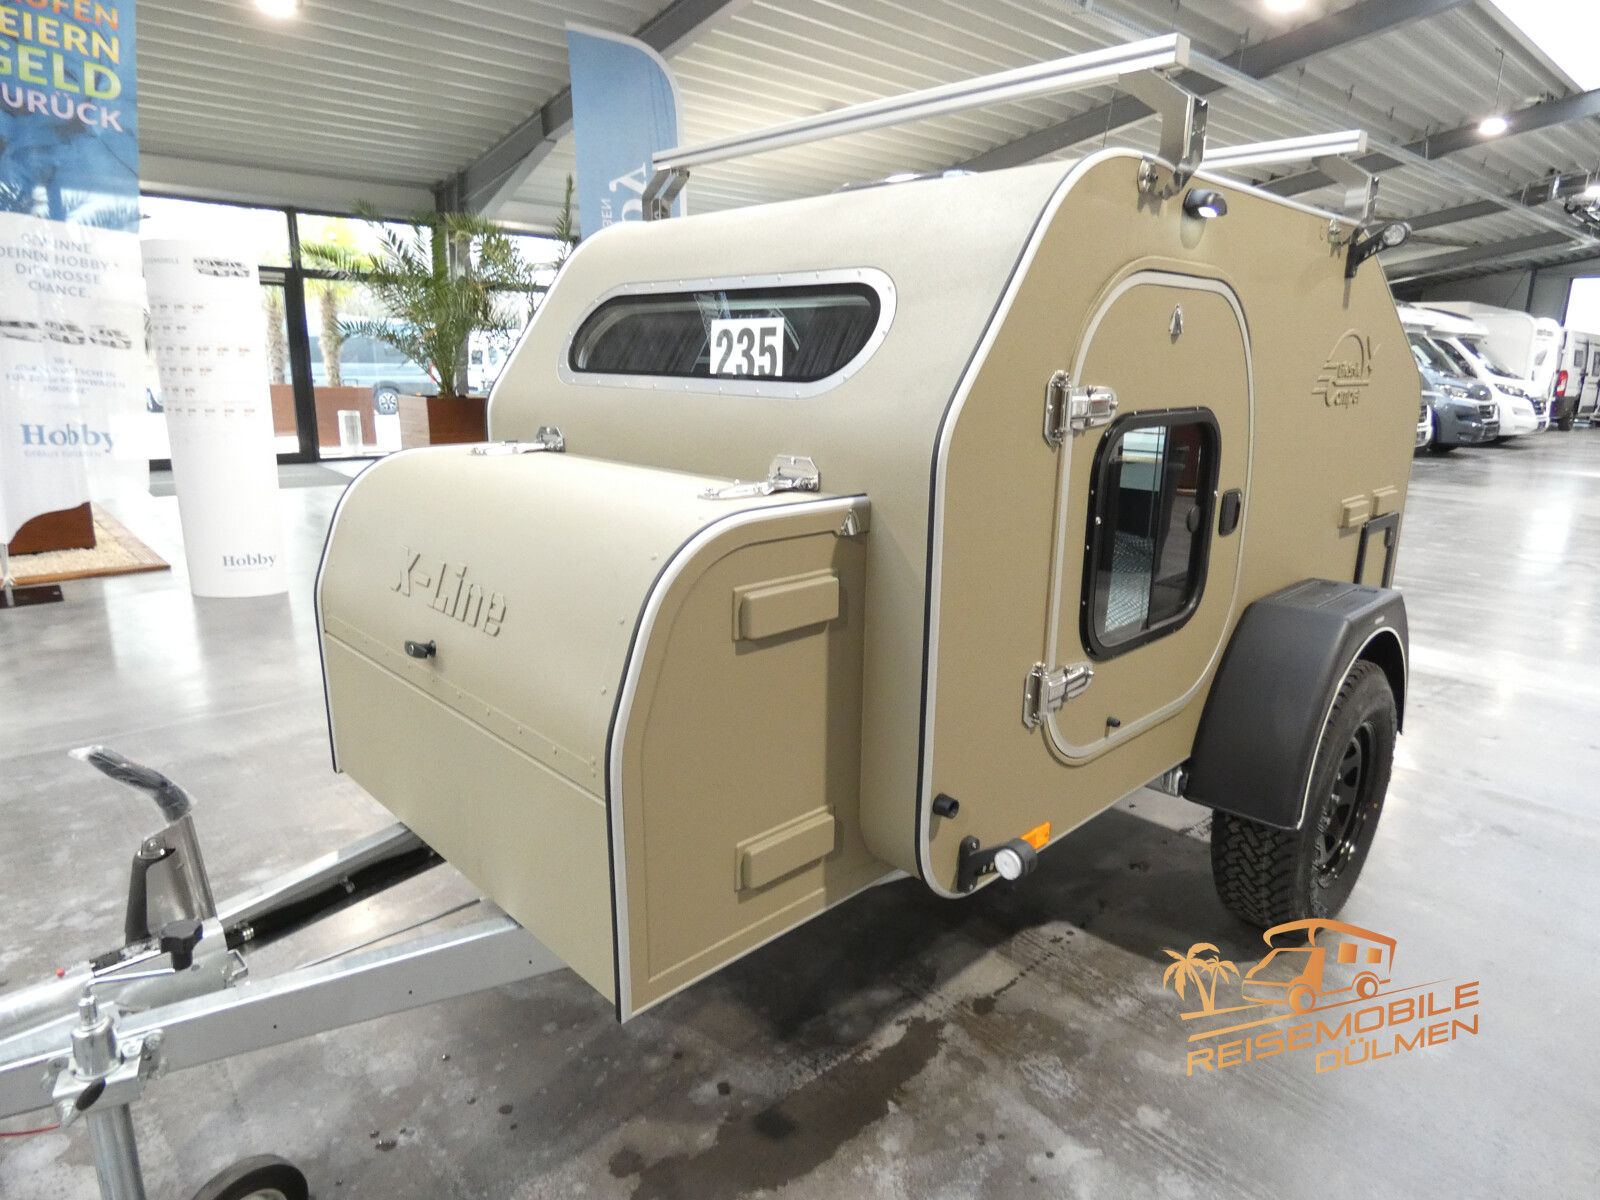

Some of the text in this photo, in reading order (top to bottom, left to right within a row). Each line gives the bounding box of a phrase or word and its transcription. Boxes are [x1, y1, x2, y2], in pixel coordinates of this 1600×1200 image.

[54, 255, 108, 270] HOBBY
[716, 326, 778, 378] 235
[20, 423, 114, 454] Hobby
[222, 553, 277, 568] Hobby
[388, 545, 507, 638] X-Line
